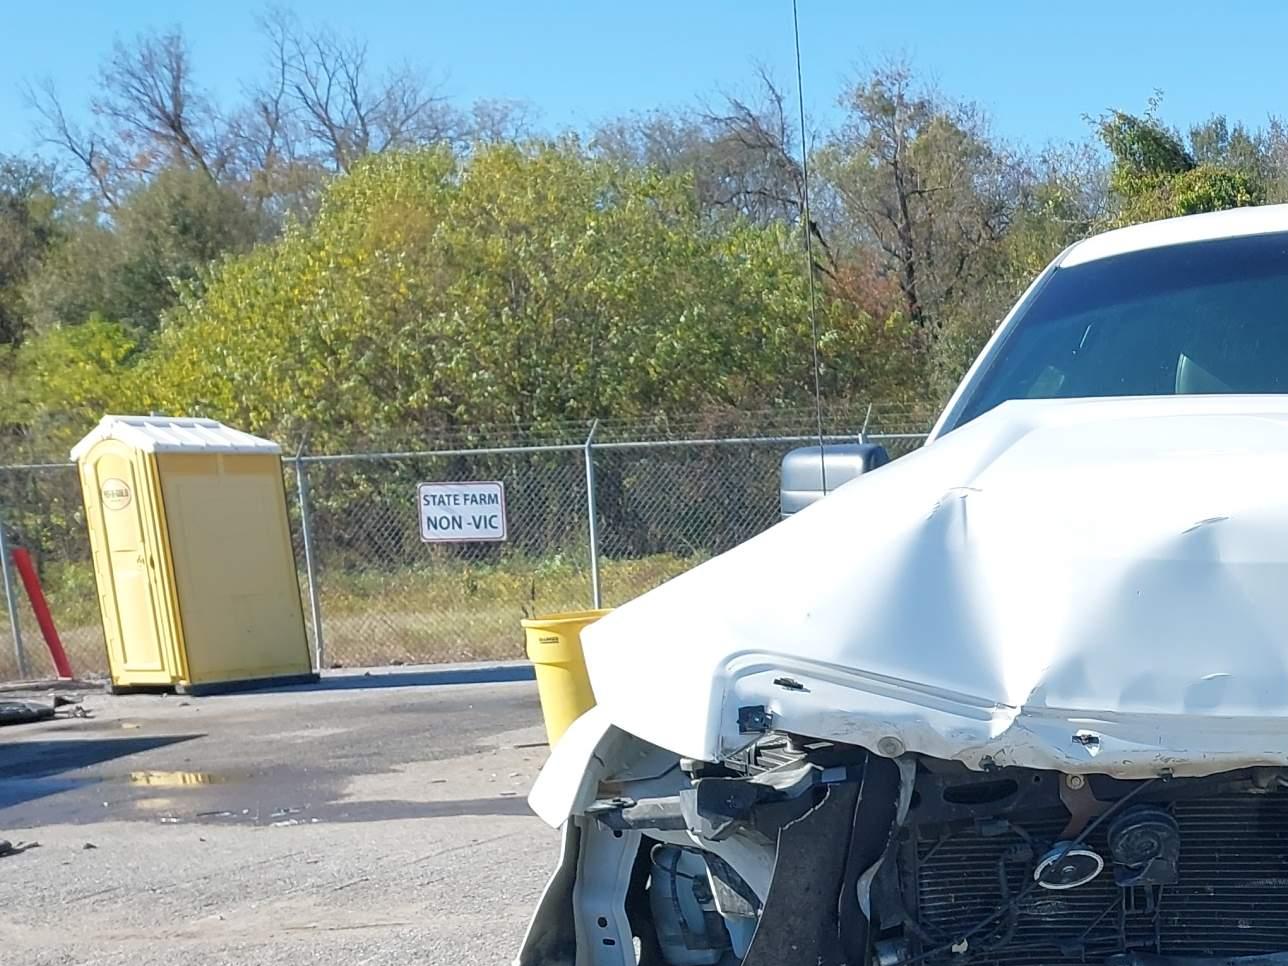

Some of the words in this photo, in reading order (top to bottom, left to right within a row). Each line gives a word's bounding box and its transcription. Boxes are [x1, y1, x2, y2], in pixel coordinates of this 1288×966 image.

[423, 494, 460, 506] STATE
[463, 493, 499, 505] FARM
[427, 515, 463, 530] NON
